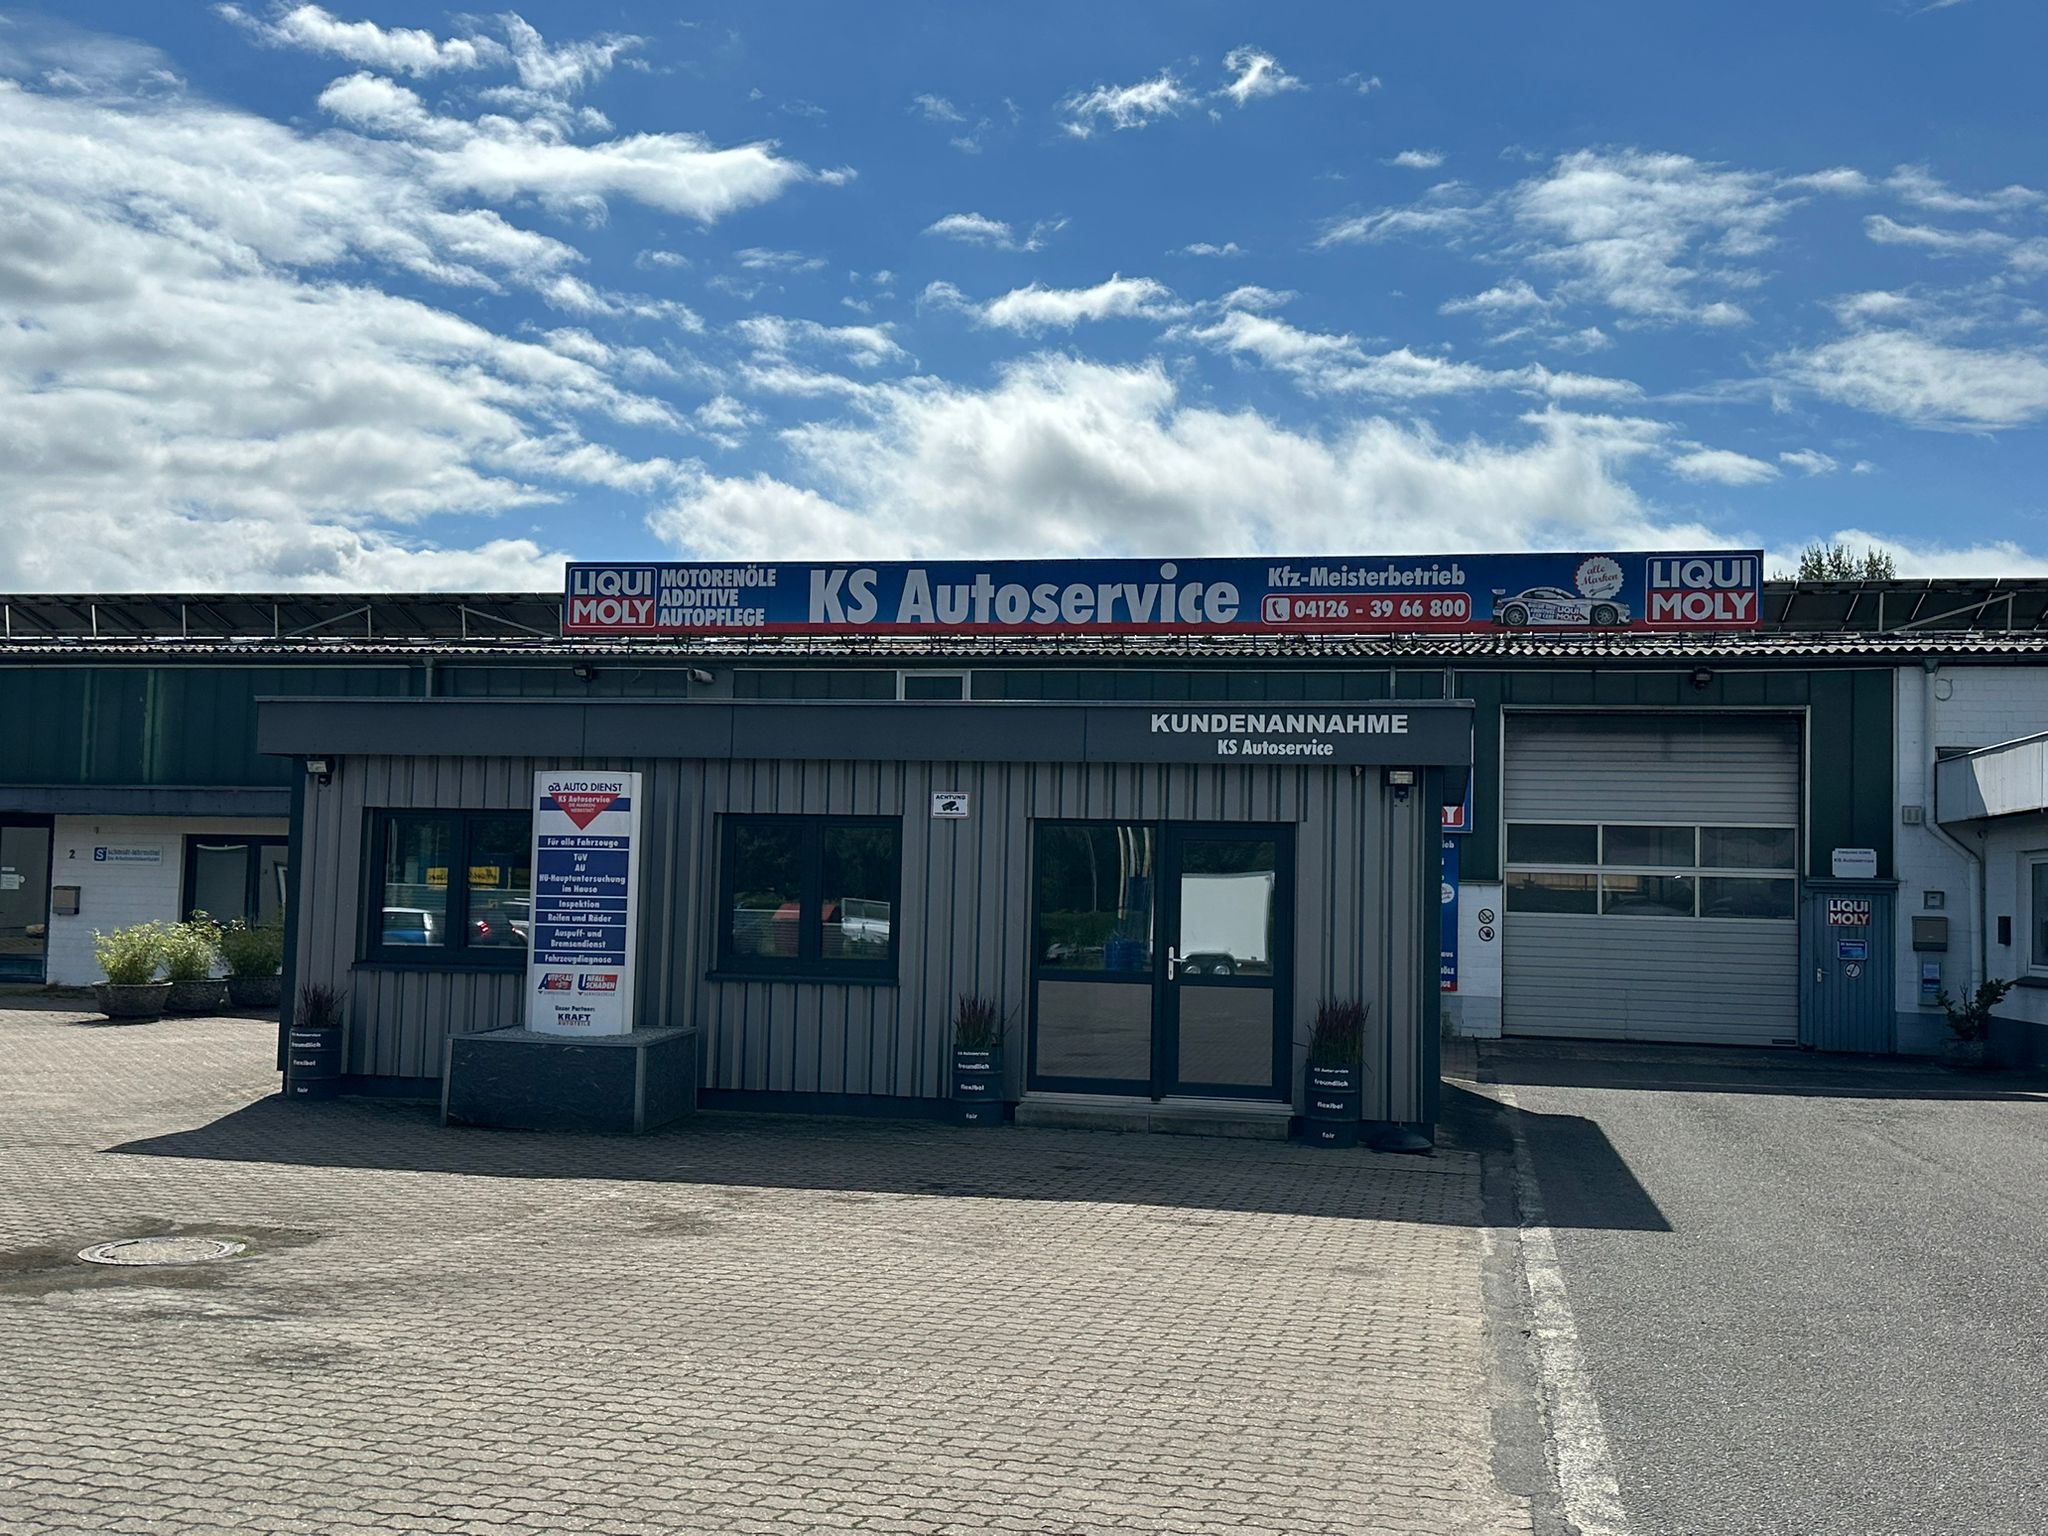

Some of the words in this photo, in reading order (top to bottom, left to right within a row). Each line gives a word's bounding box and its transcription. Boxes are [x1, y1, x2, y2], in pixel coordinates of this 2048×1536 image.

[1587, 564, 1605, 574] alle
[1653, 560, 1751, 589] LIQUI
[660, 564, 776, 587] MOTORENÖLE
[1268, 564, 1465, 587] Kfz-Meisterbetrieb
[575, 571, 651, 596] LIQUI
[659, 589, 738, 606] ADDITIVE
[809, 569, 878, 624] KS
[896, 562, 1240, 624] Autoservice
[573, 599, 653, 624] MOLY
[1295, 600, 1348, 617] 04126
[1370, 600, 1393, 617] 39
[1400, 600, 1423, 617] 66
[1430, 599, 1466, 617] 800
[1652, 592, 1755, 620] MOLY
[659, 608, 764, 626] AUTOPFLEGE
[1151, 714, 1408, 734] KUNDENANNAHME
[1218, 739, 1237, 755] KS
[1242, 738, 1334, 755] Autoservice
[564, 783, 588, 791] AUTO
[591, 783, 622, 792] DIENST
[568, 795, 610, 803] Autoservice
[561, 838, 574, 846] alle
[577, 838, 619, 848] Fahrzeuge
[69, 849, 75, 859] 2
[574, 864, 586, 872] AU
[574, 885, 597, 893] Hause
[559, 900, 600, 909] Inspektion
[1830, 900, 1868, 912] LIQUI
[548, 913, 570, 921] Reifen
[572, 914, 586, 922] und
[588, 914, 612, 922] Räder
[1830, 913, 1869, 924] MOLY
[555, 929, 585, 938] Auspuff-
[587, 929, 602, 937] und
[551, 940, 606, 948] Bremsendienst
[545, 954, 612, 965] Fahrzeugdiagnose
[558, 1013, 590, 1021] KRAFT
